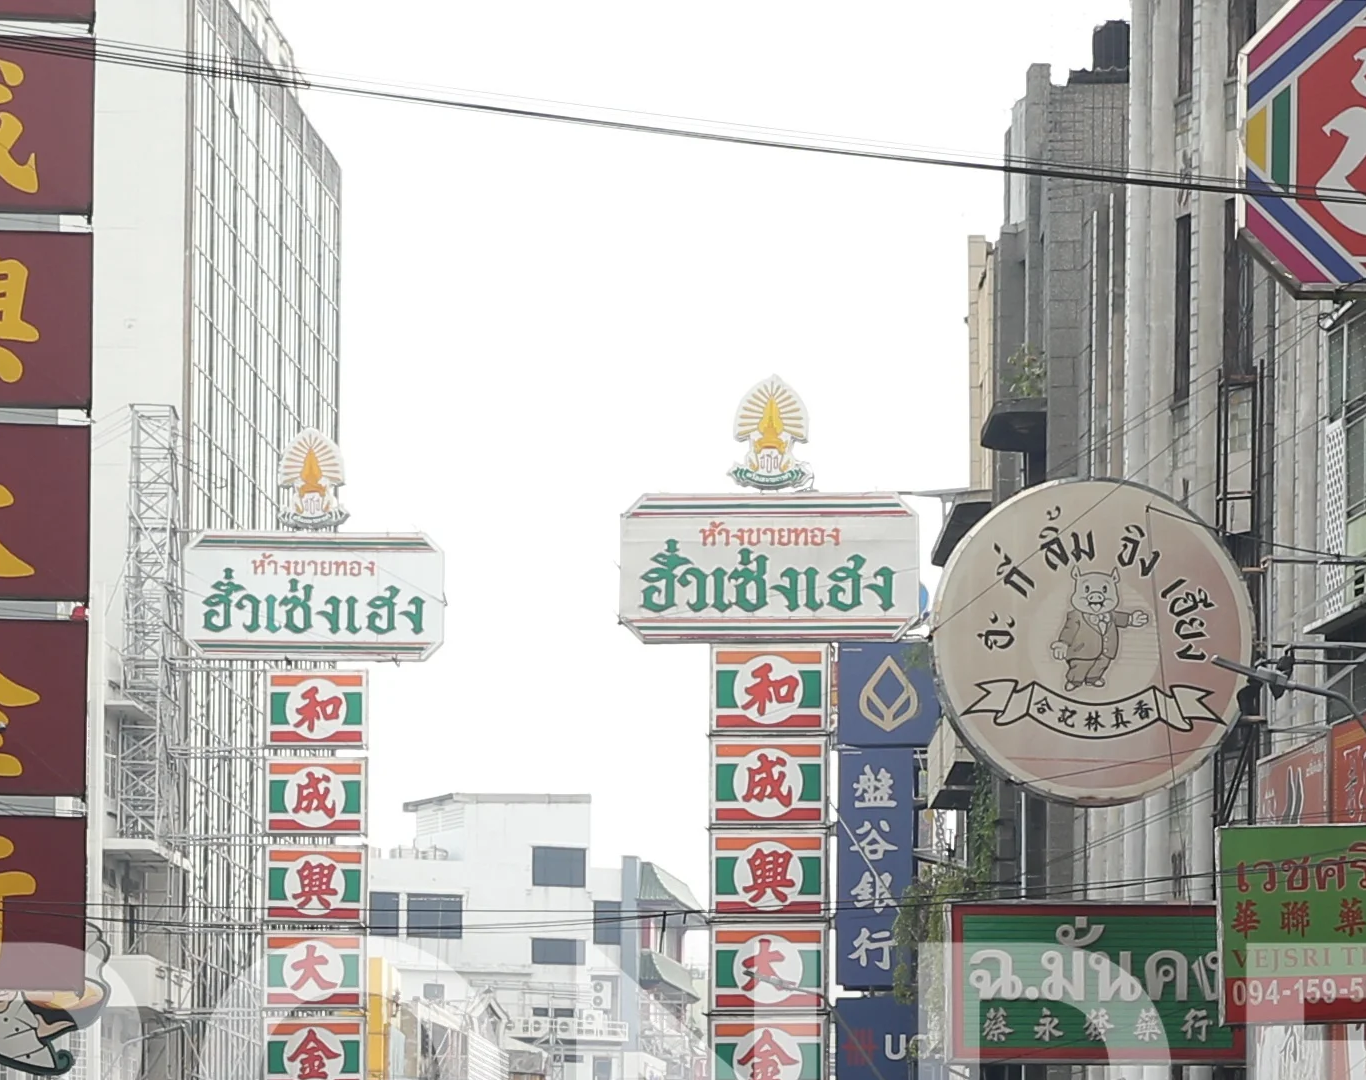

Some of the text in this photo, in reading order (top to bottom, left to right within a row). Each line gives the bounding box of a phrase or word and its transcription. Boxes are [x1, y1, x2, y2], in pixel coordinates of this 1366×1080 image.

[699, 520, 842, 547] ห้างขายทอง
[251, 553, 376, 577] ห้างขายทอง
[1232, 946, 1331, 972] VEJSRI
